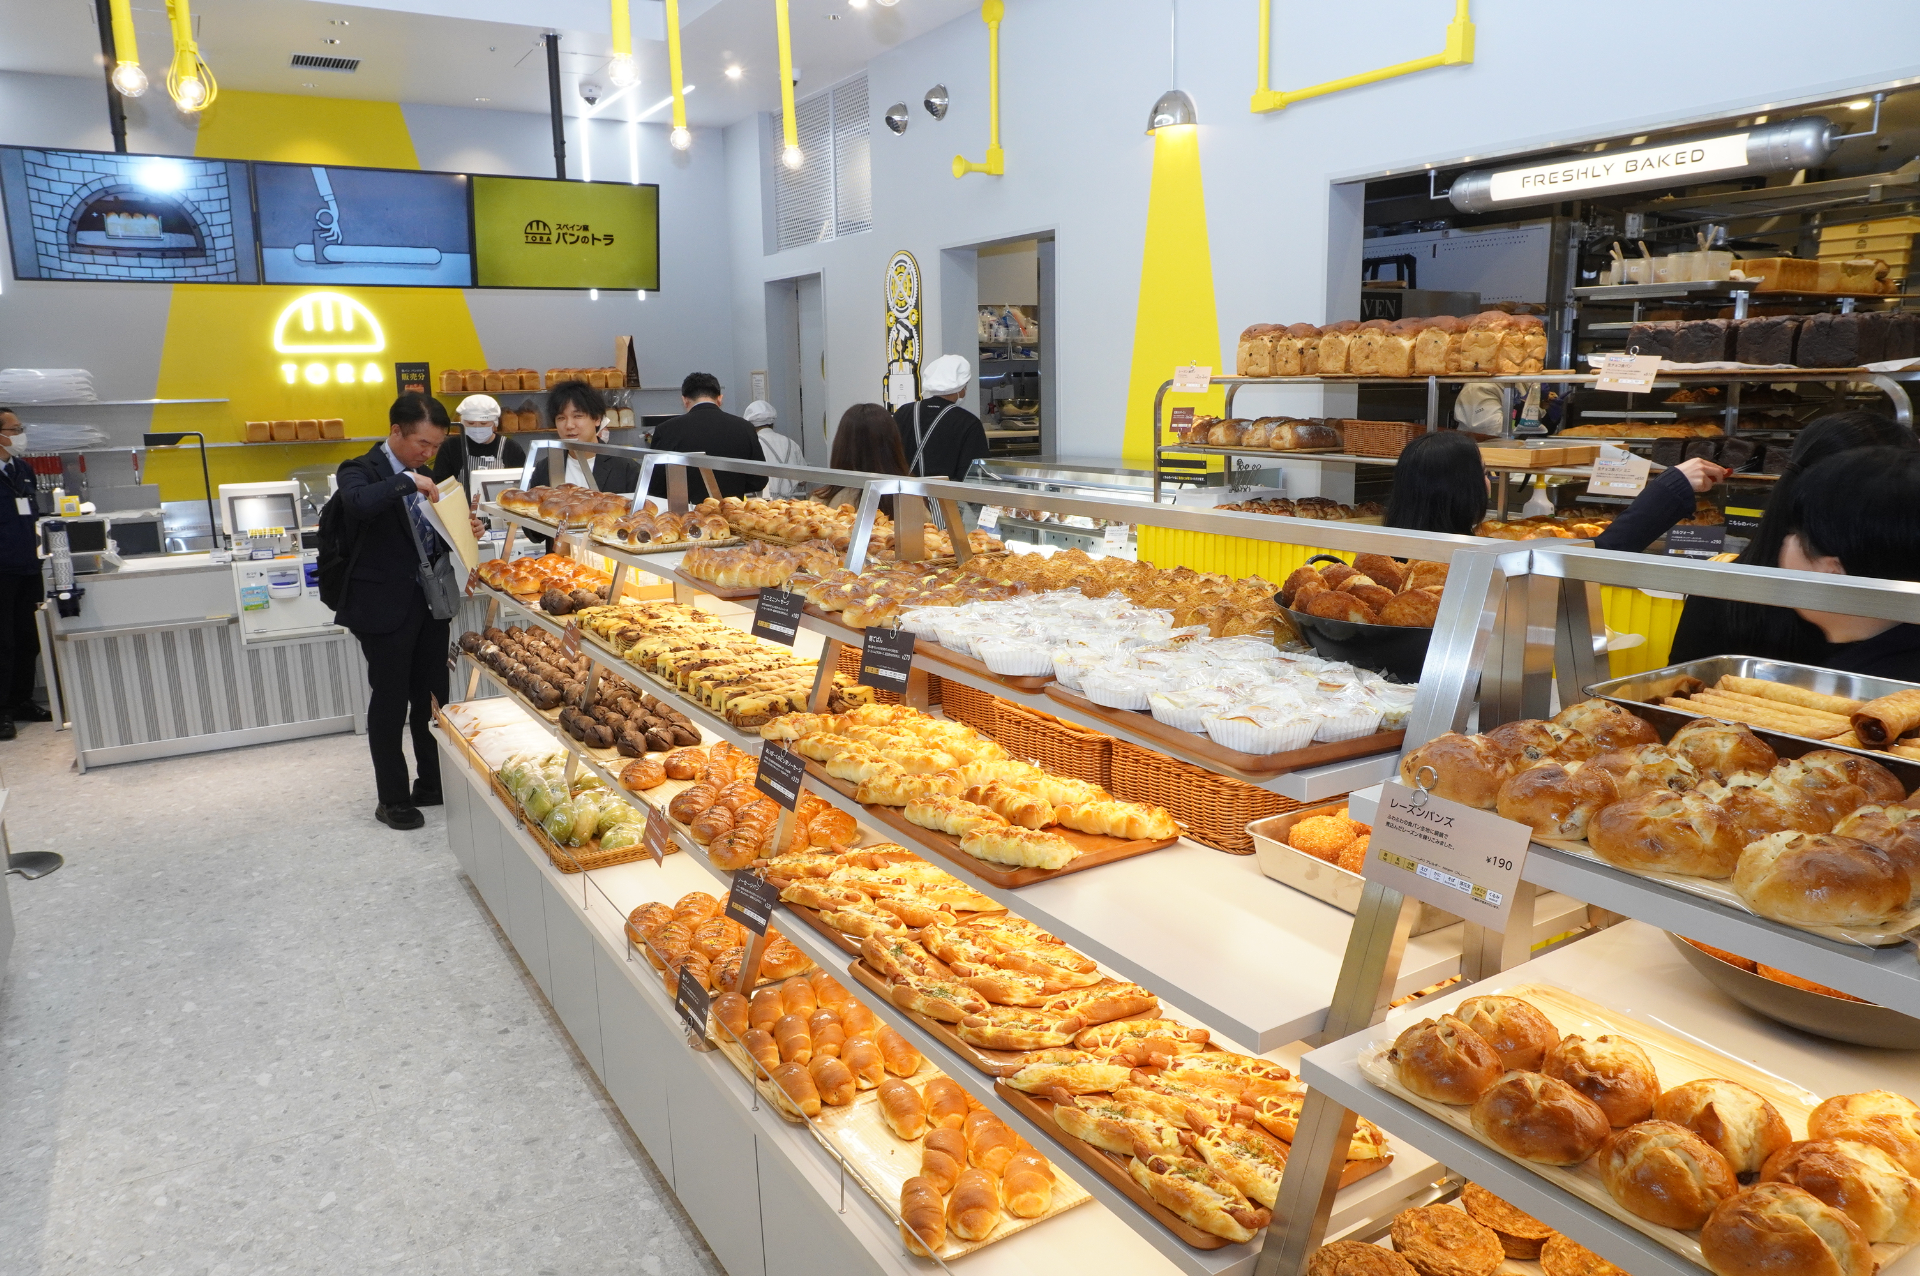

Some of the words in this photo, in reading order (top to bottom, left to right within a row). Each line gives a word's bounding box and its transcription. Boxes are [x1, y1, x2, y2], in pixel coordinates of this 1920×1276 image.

[1522, 163, 1615, 188] FRESHLY
[1625, 149, 1705, 173] BAKED
[555, 232, 615, 246] パンのトラ
[281, 362, 384, 385] TORA
[1390, 798, 1455, 828] レーズンバンズ
[1486, 855, 1513, 871] ¥190
